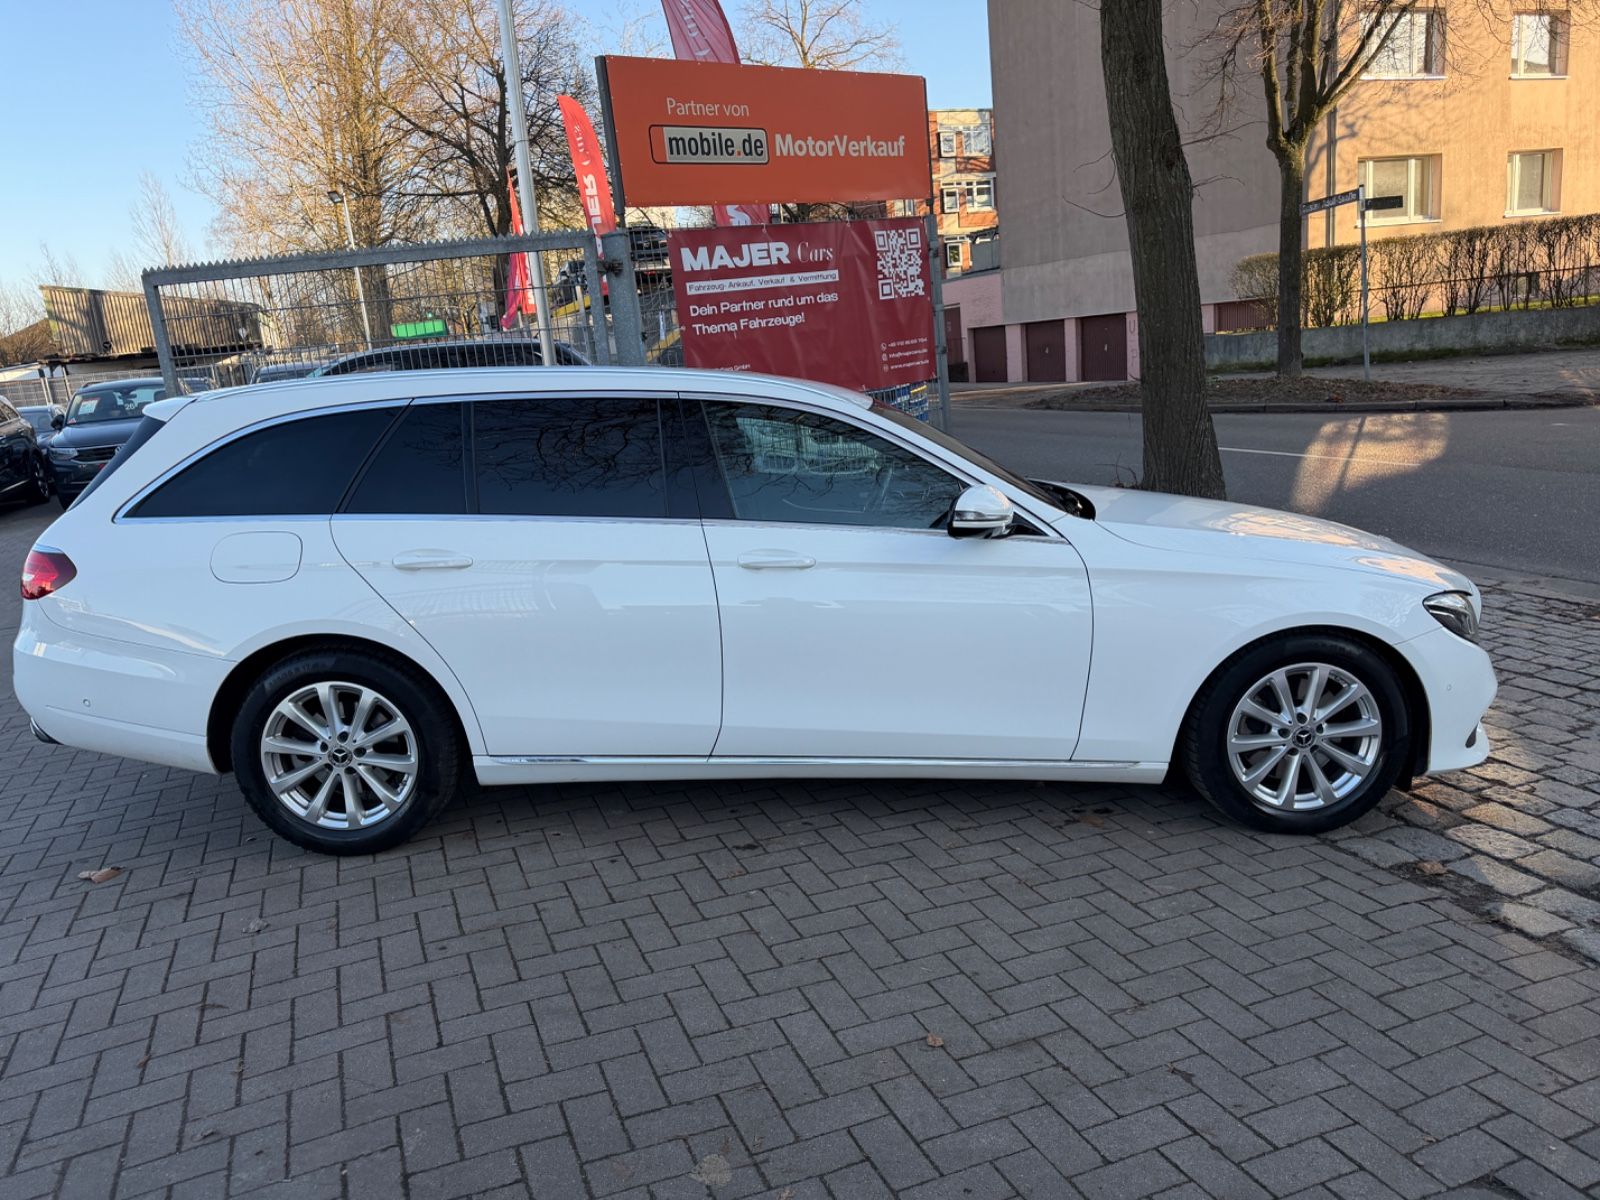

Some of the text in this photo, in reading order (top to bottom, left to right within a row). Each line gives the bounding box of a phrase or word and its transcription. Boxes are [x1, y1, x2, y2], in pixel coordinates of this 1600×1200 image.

[666, 97, 750, 117] Partner von
[668, 132, 905, 157] mobile.de MotorVerkauf
[680, 241, 834, 272] MAJER Cars
[758, 277, 785, 286] Verkauf
[797, 273, 837, 282] Vermittlung
[689, 292, 839, 317] Dein Partner rund um das
[692, 312, 806, 336] Thema Fahrzeuge!
